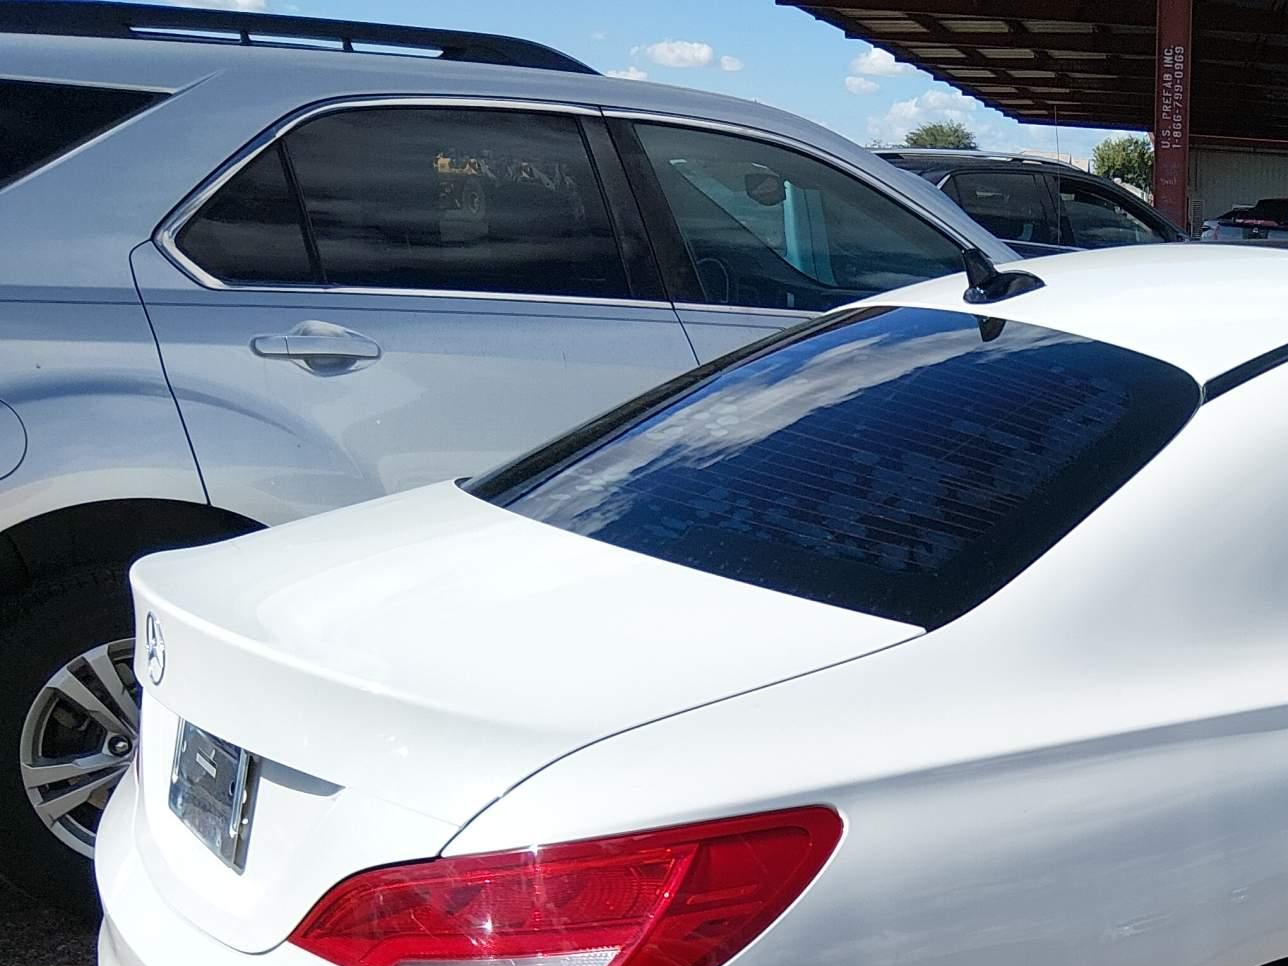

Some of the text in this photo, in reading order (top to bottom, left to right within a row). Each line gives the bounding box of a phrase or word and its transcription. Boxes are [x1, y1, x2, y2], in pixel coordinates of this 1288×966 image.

[1161, 45, 1174, 149] U.S. PREFAB INC.
[1172, 46, 1185, 149] 1-866-799-0969
